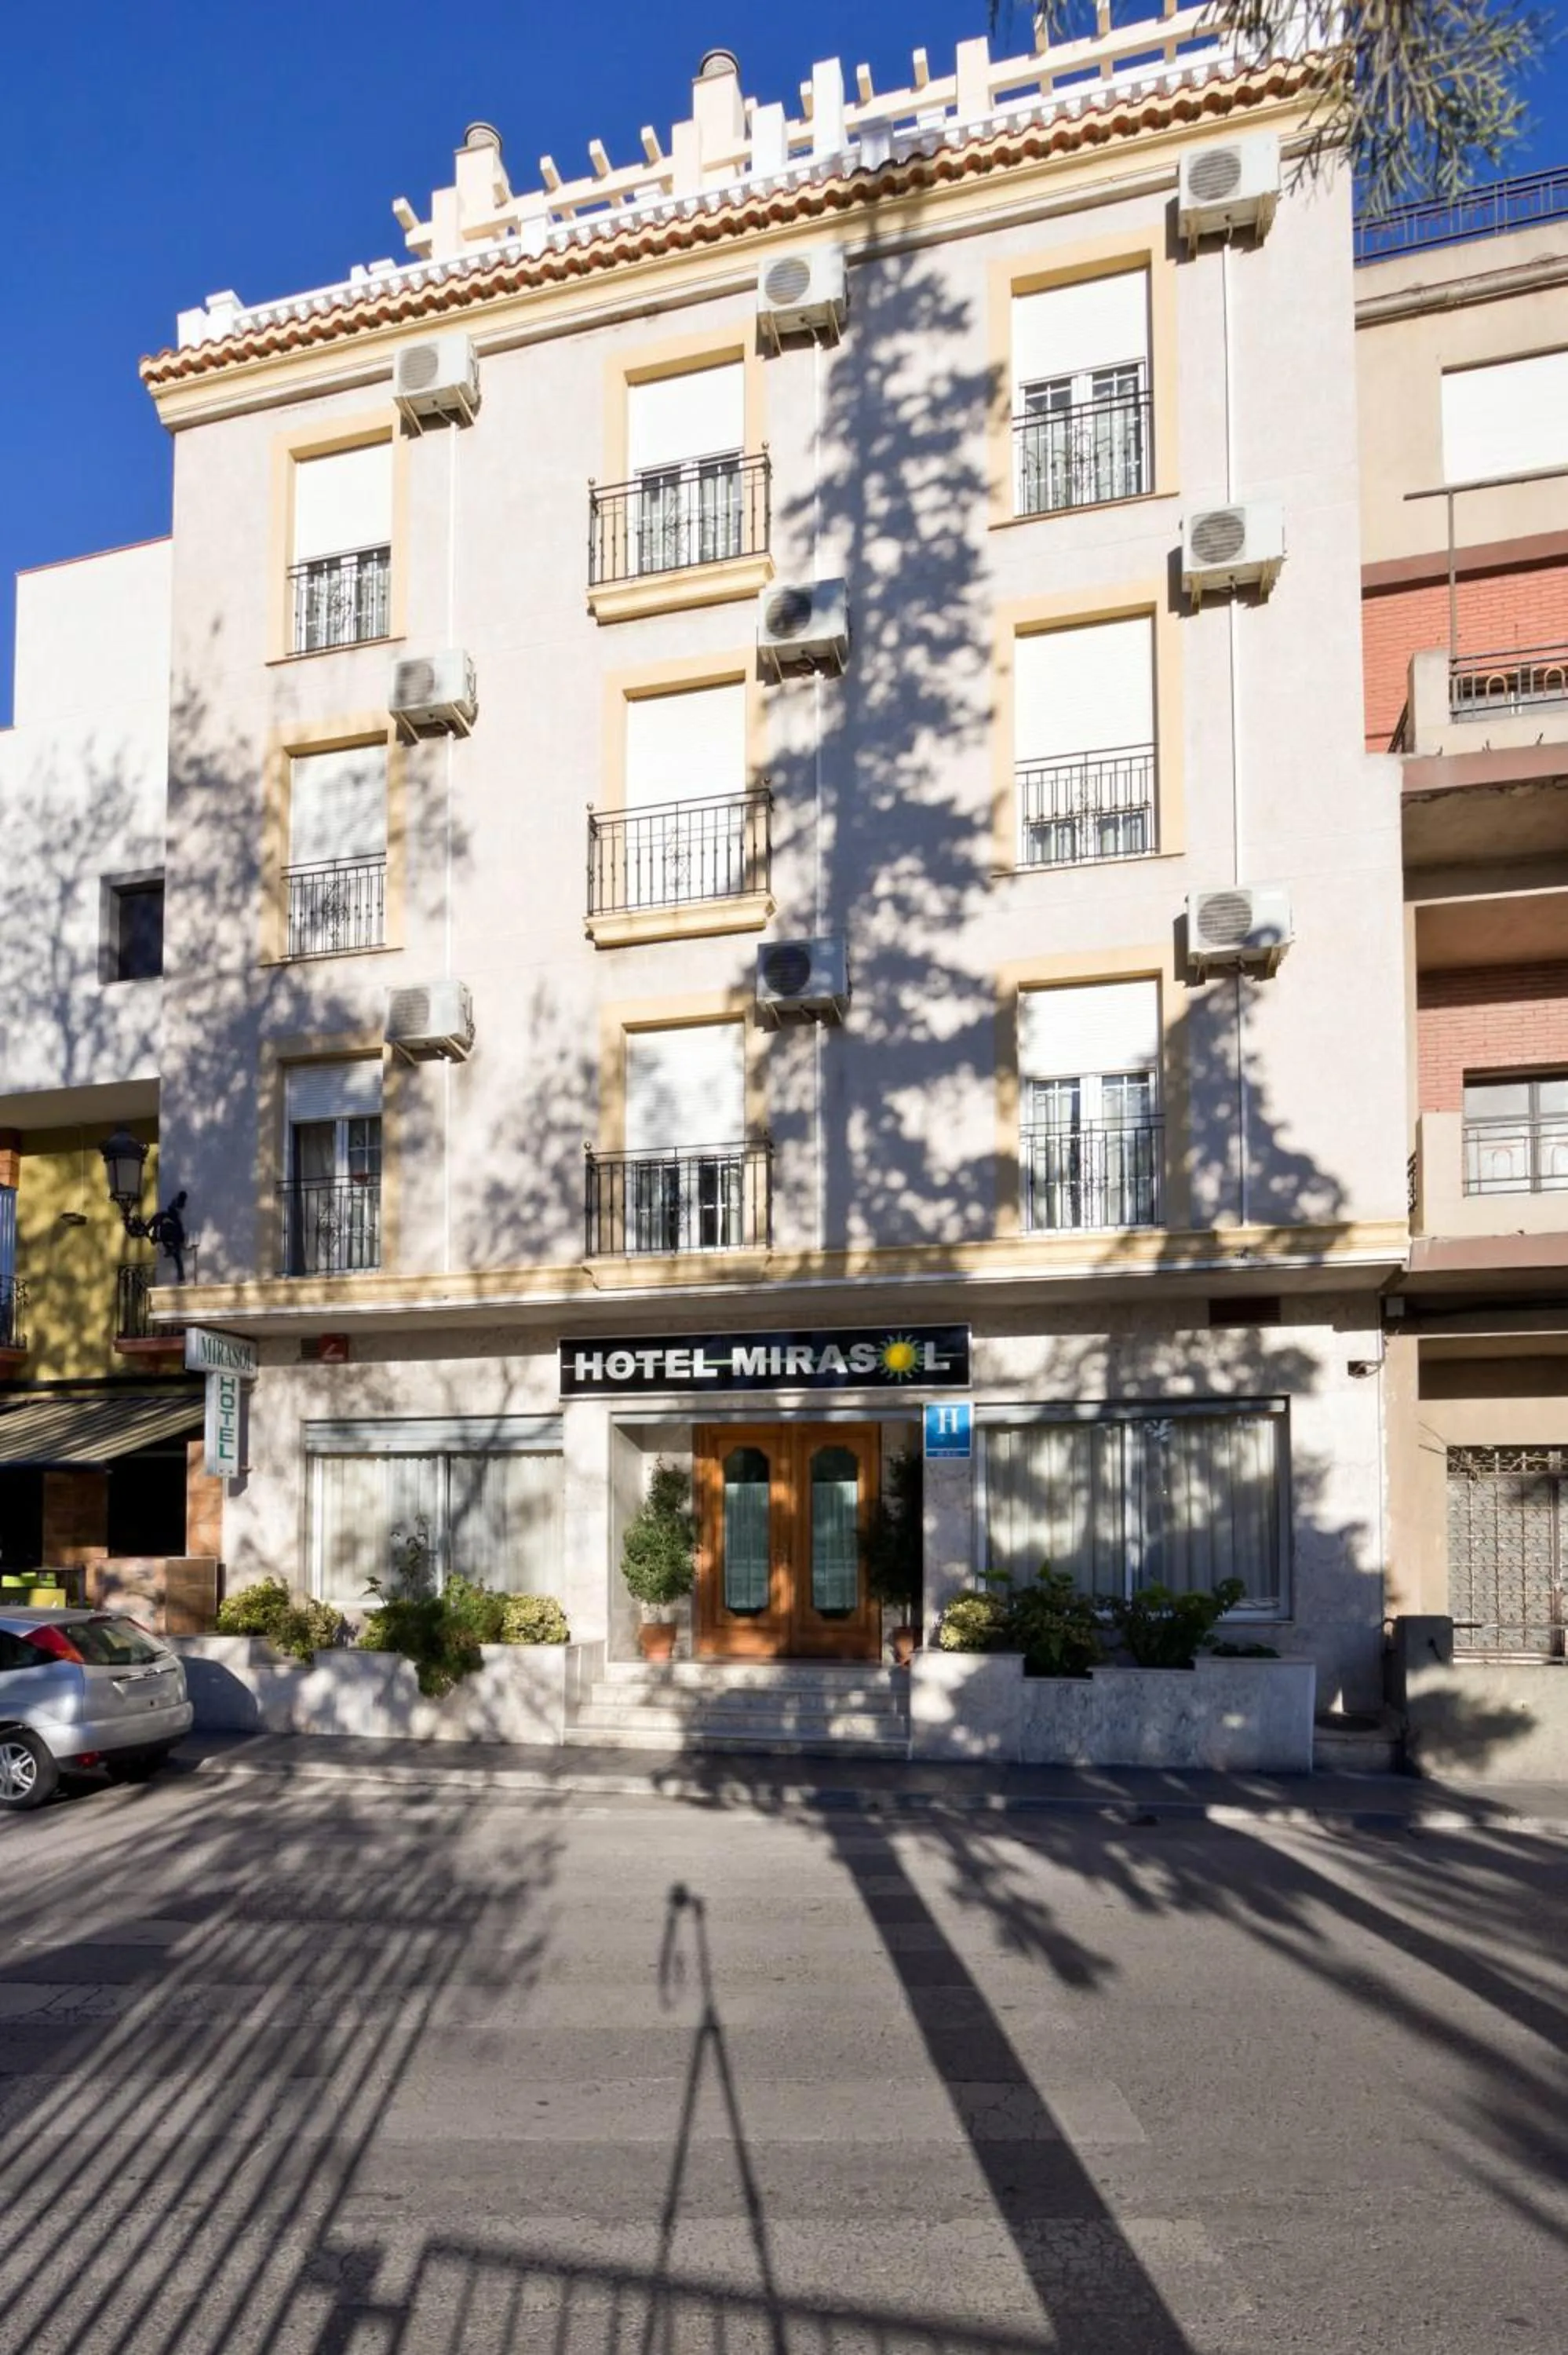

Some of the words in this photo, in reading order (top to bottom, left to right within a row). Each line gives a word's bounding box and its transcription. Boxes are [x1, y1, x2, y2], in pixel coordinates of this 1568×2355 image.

[201, 1336, 253, 1371] MIRASOL
[574, 1349, 717, 1381] HOTEL
[731, 1337, 950, 1379] MIRASOL
[219, 1376, 235, 1459] HOTEL
[937, 1407, 960, 1434] H
